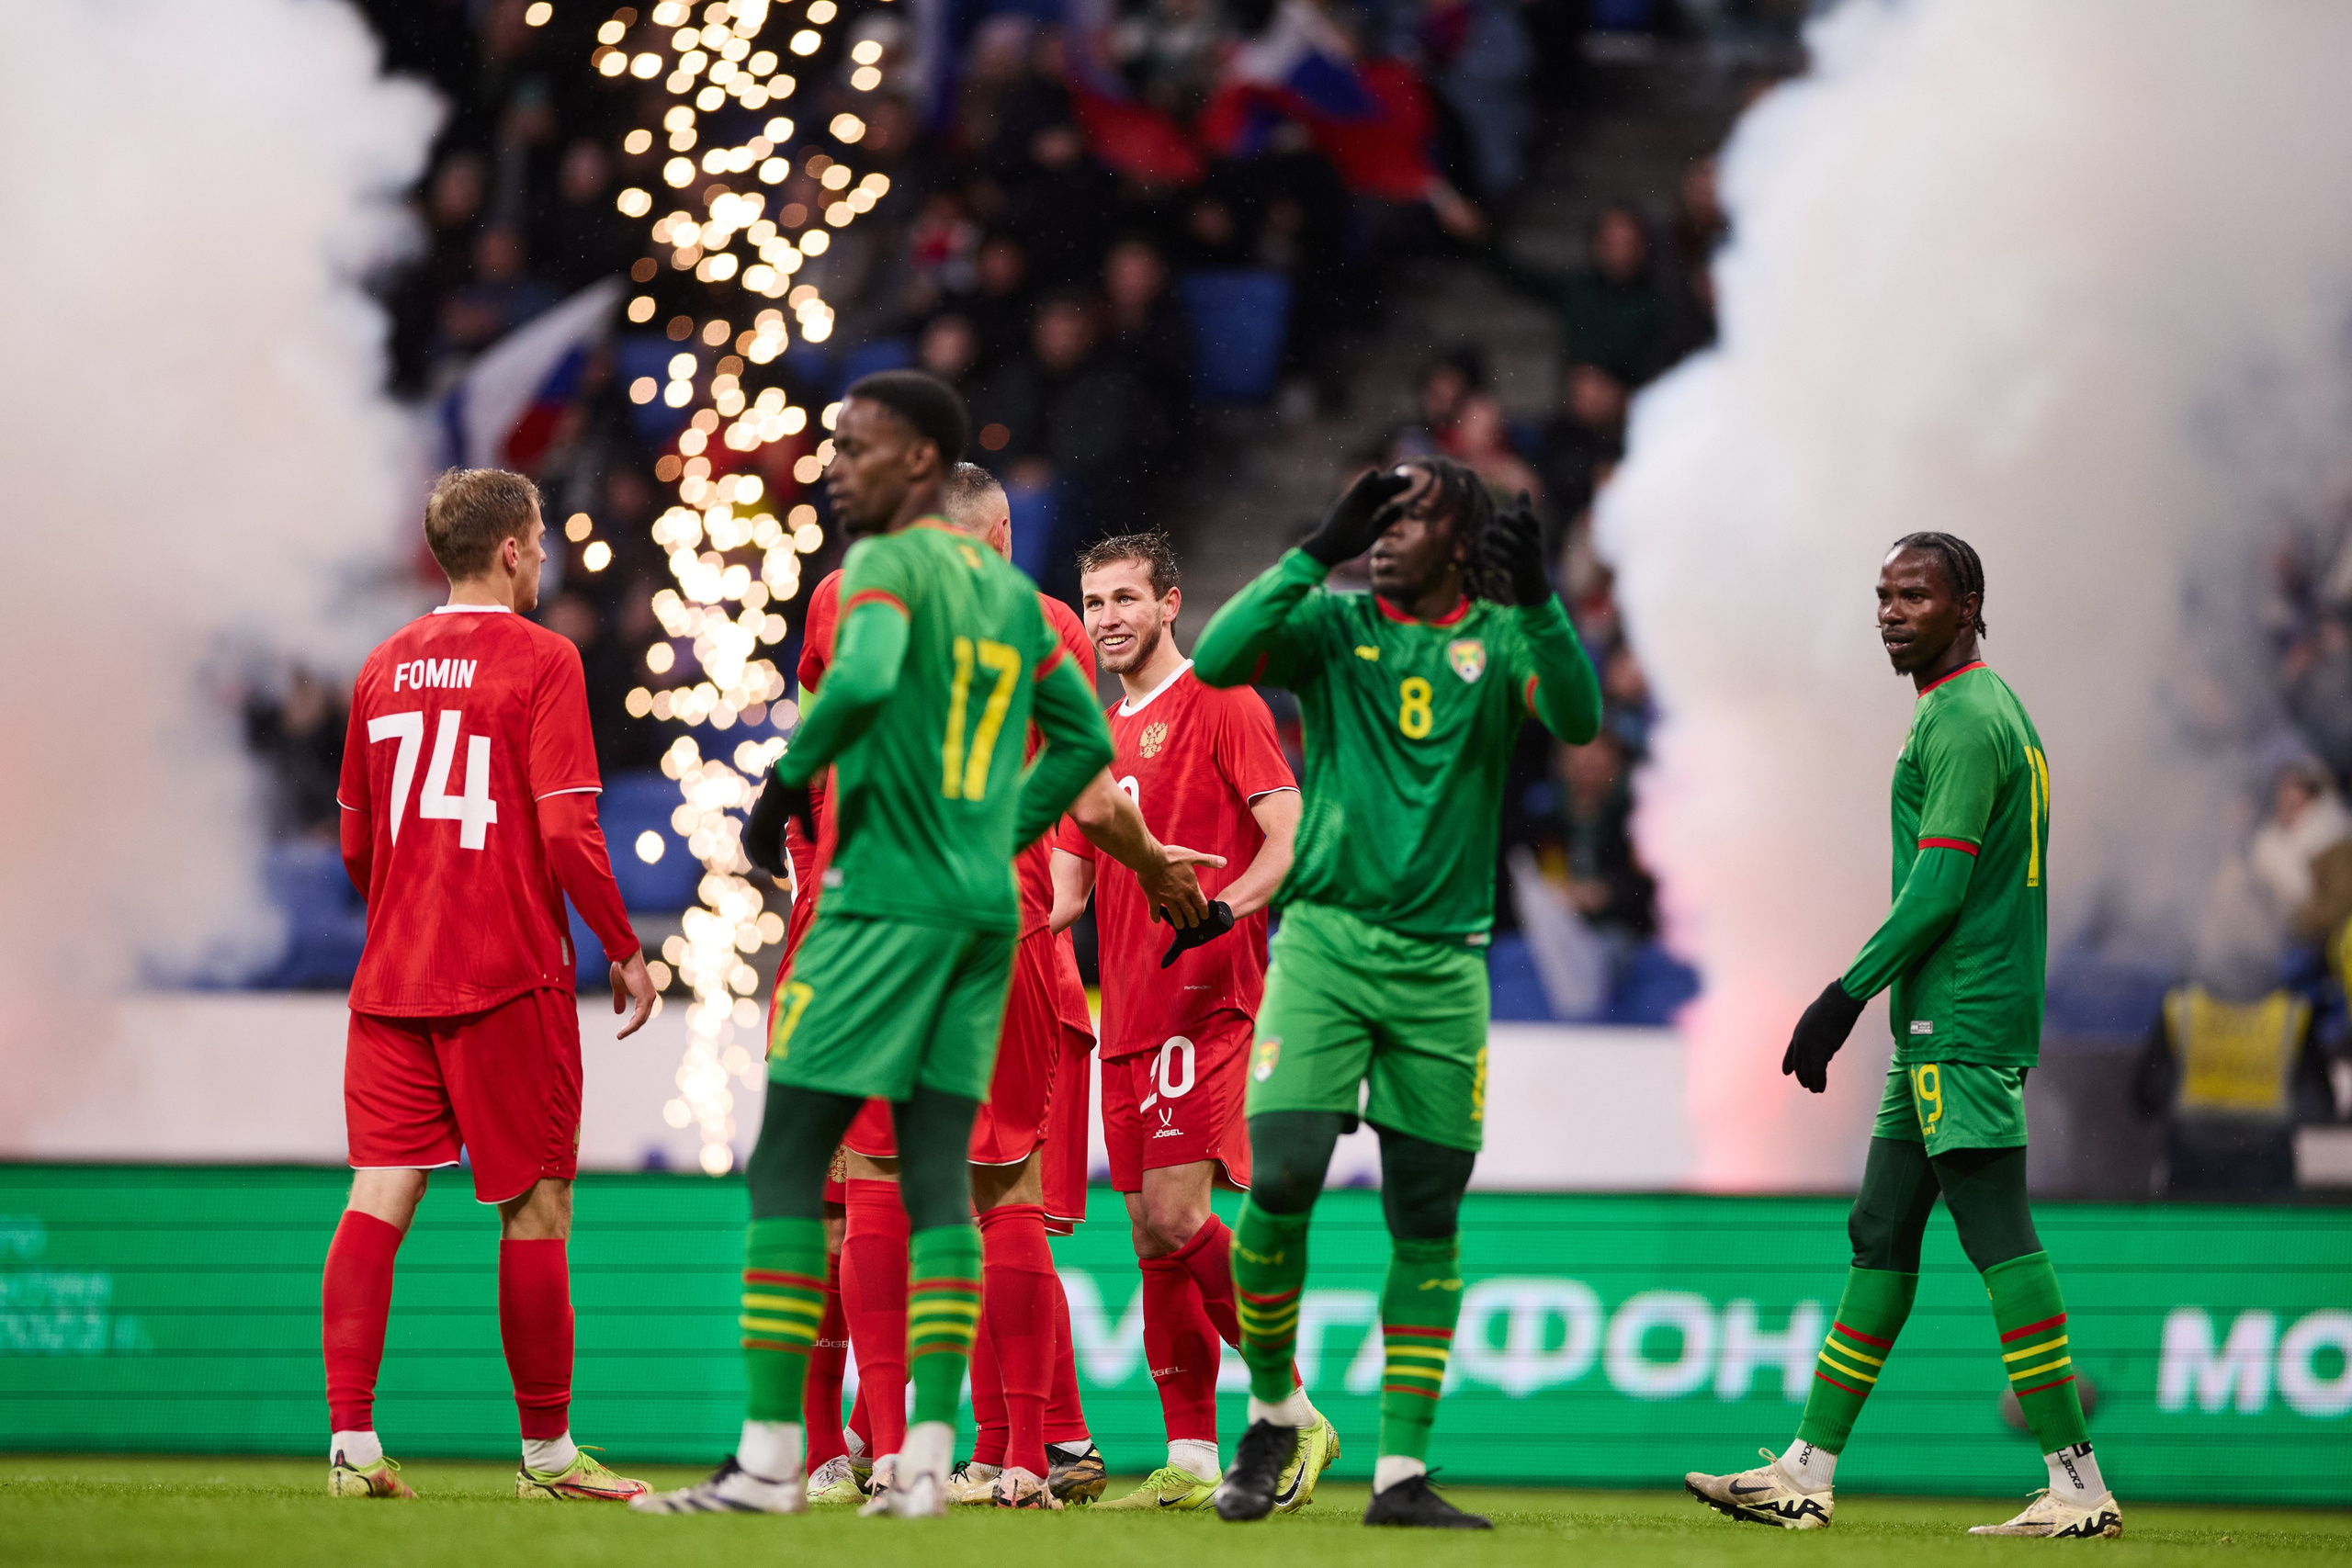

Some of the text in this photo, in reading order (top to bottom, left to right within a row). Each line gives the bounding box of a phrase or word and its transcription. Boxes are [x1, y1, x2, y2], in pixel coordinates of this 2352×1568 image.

[394, 659, 477, 692] FOMIN
[942, 636, 1022, 802] 17
[1399, 676, 1432, 739] 8
[368, 710, 497, 850] 74
[1152, 1129, 1184, 1139] JÖGEL
